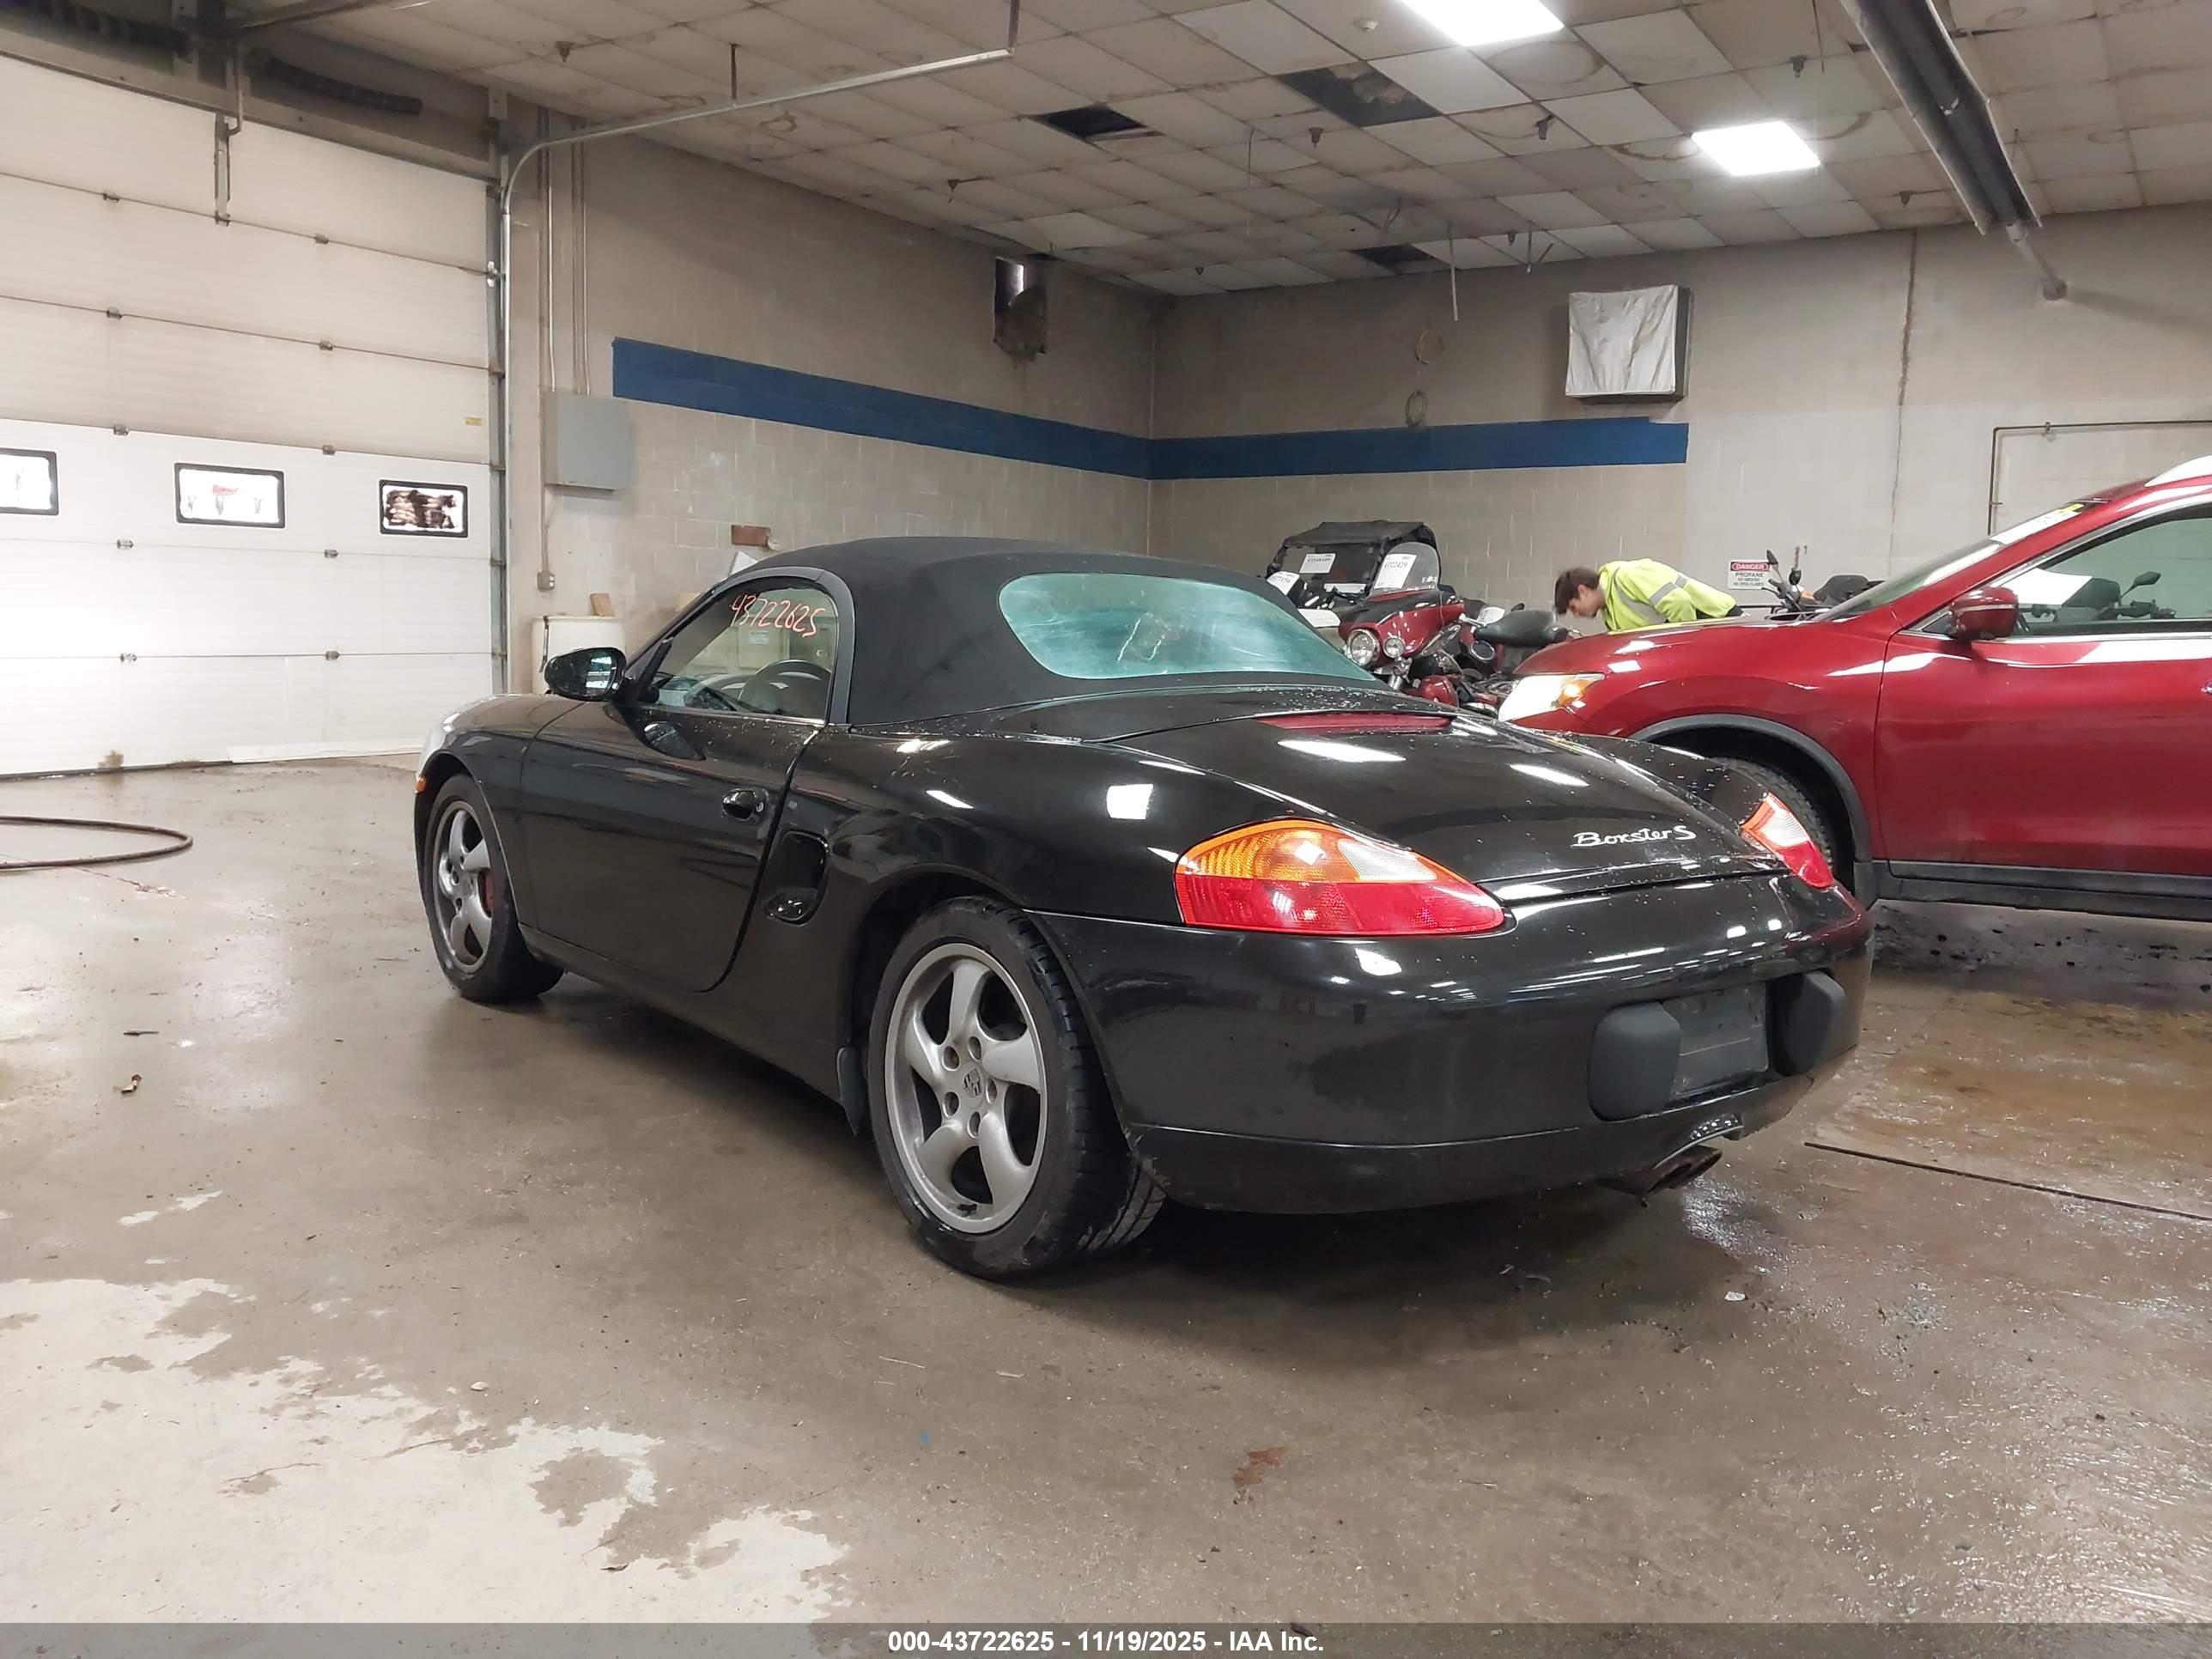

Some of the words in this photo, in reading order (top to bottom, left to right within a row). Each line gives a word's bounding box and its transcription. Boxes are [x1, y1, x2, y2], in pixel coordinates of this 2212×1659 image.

[1735, 562, 1765, 571] DANGER
[730, 593, 826, 638] 43722625
[1570, 829, 1672, 848] Boxster
[1672, 825, 1696, 841] S
